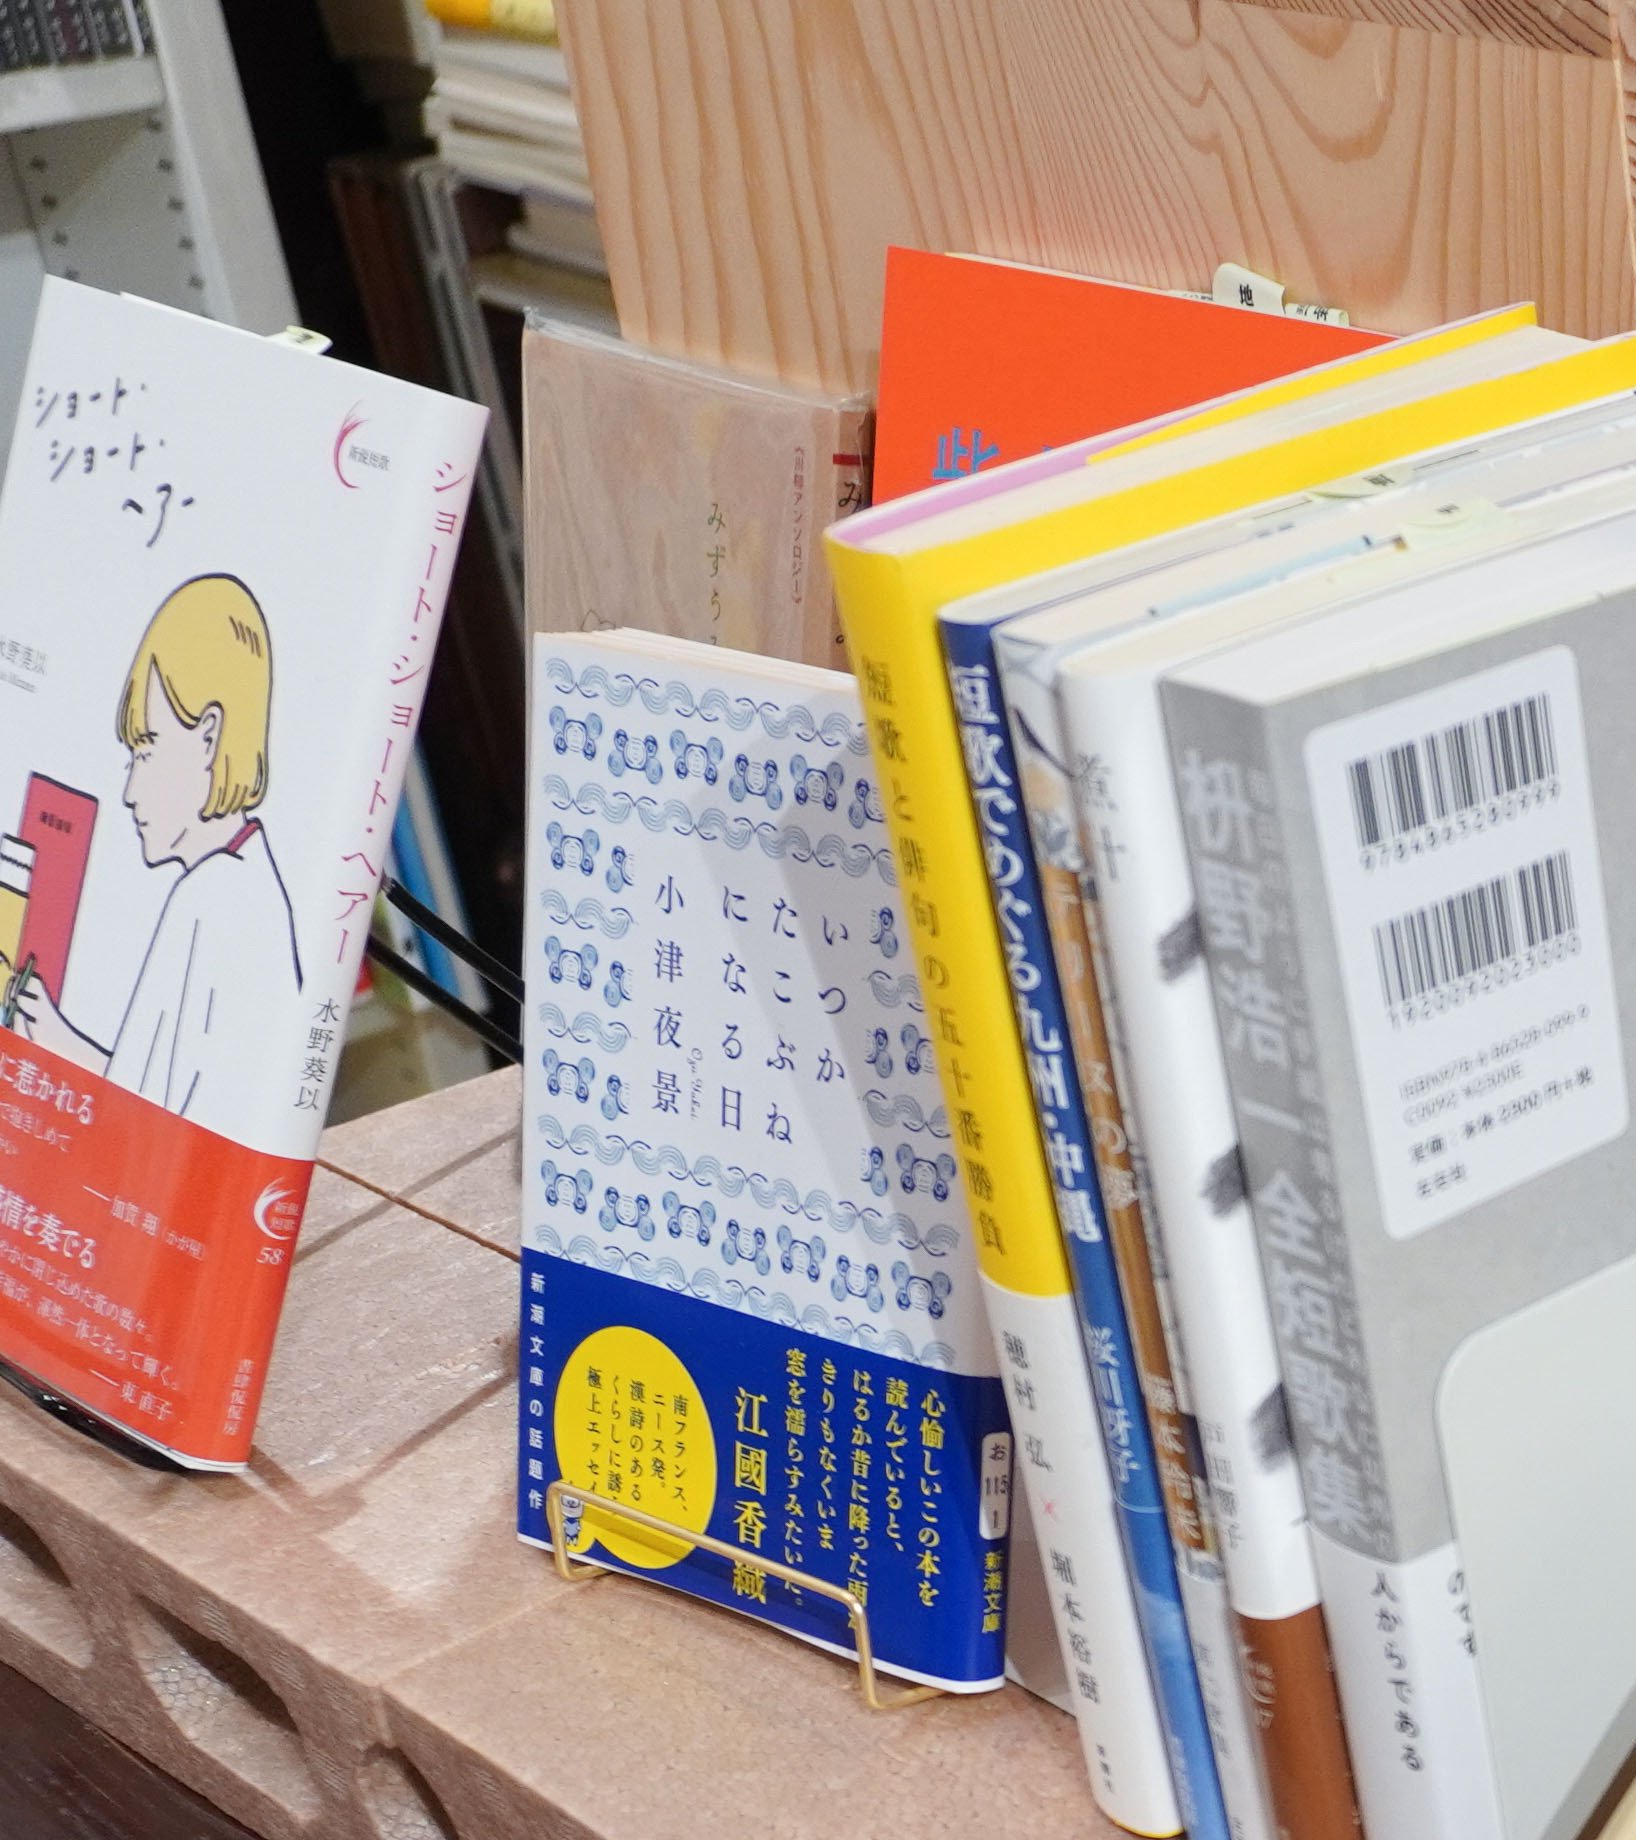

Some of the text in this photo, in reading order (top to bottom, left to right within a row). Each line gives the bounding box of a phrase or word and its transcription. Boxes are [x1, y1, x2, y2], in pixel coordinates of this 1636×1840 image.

[292, 996, 341, 1113] 水野葵以
[650, 874, 685, 1116] 小津夜景
[720, 884, 749, 1131] になる日
[766, 895, 798, 1144] たこぶね
[817, 915, 850, 1084] いつか
[256, 1246, 286, 1266] 58
[607, 1374, 624, 1502] くらしに誘
[732, 1385, 769, 1605] 江國香織
[816, 1357, 838, 1552] きりもなくいま
[885, 1376, 910, 1553] 読んでいると、
